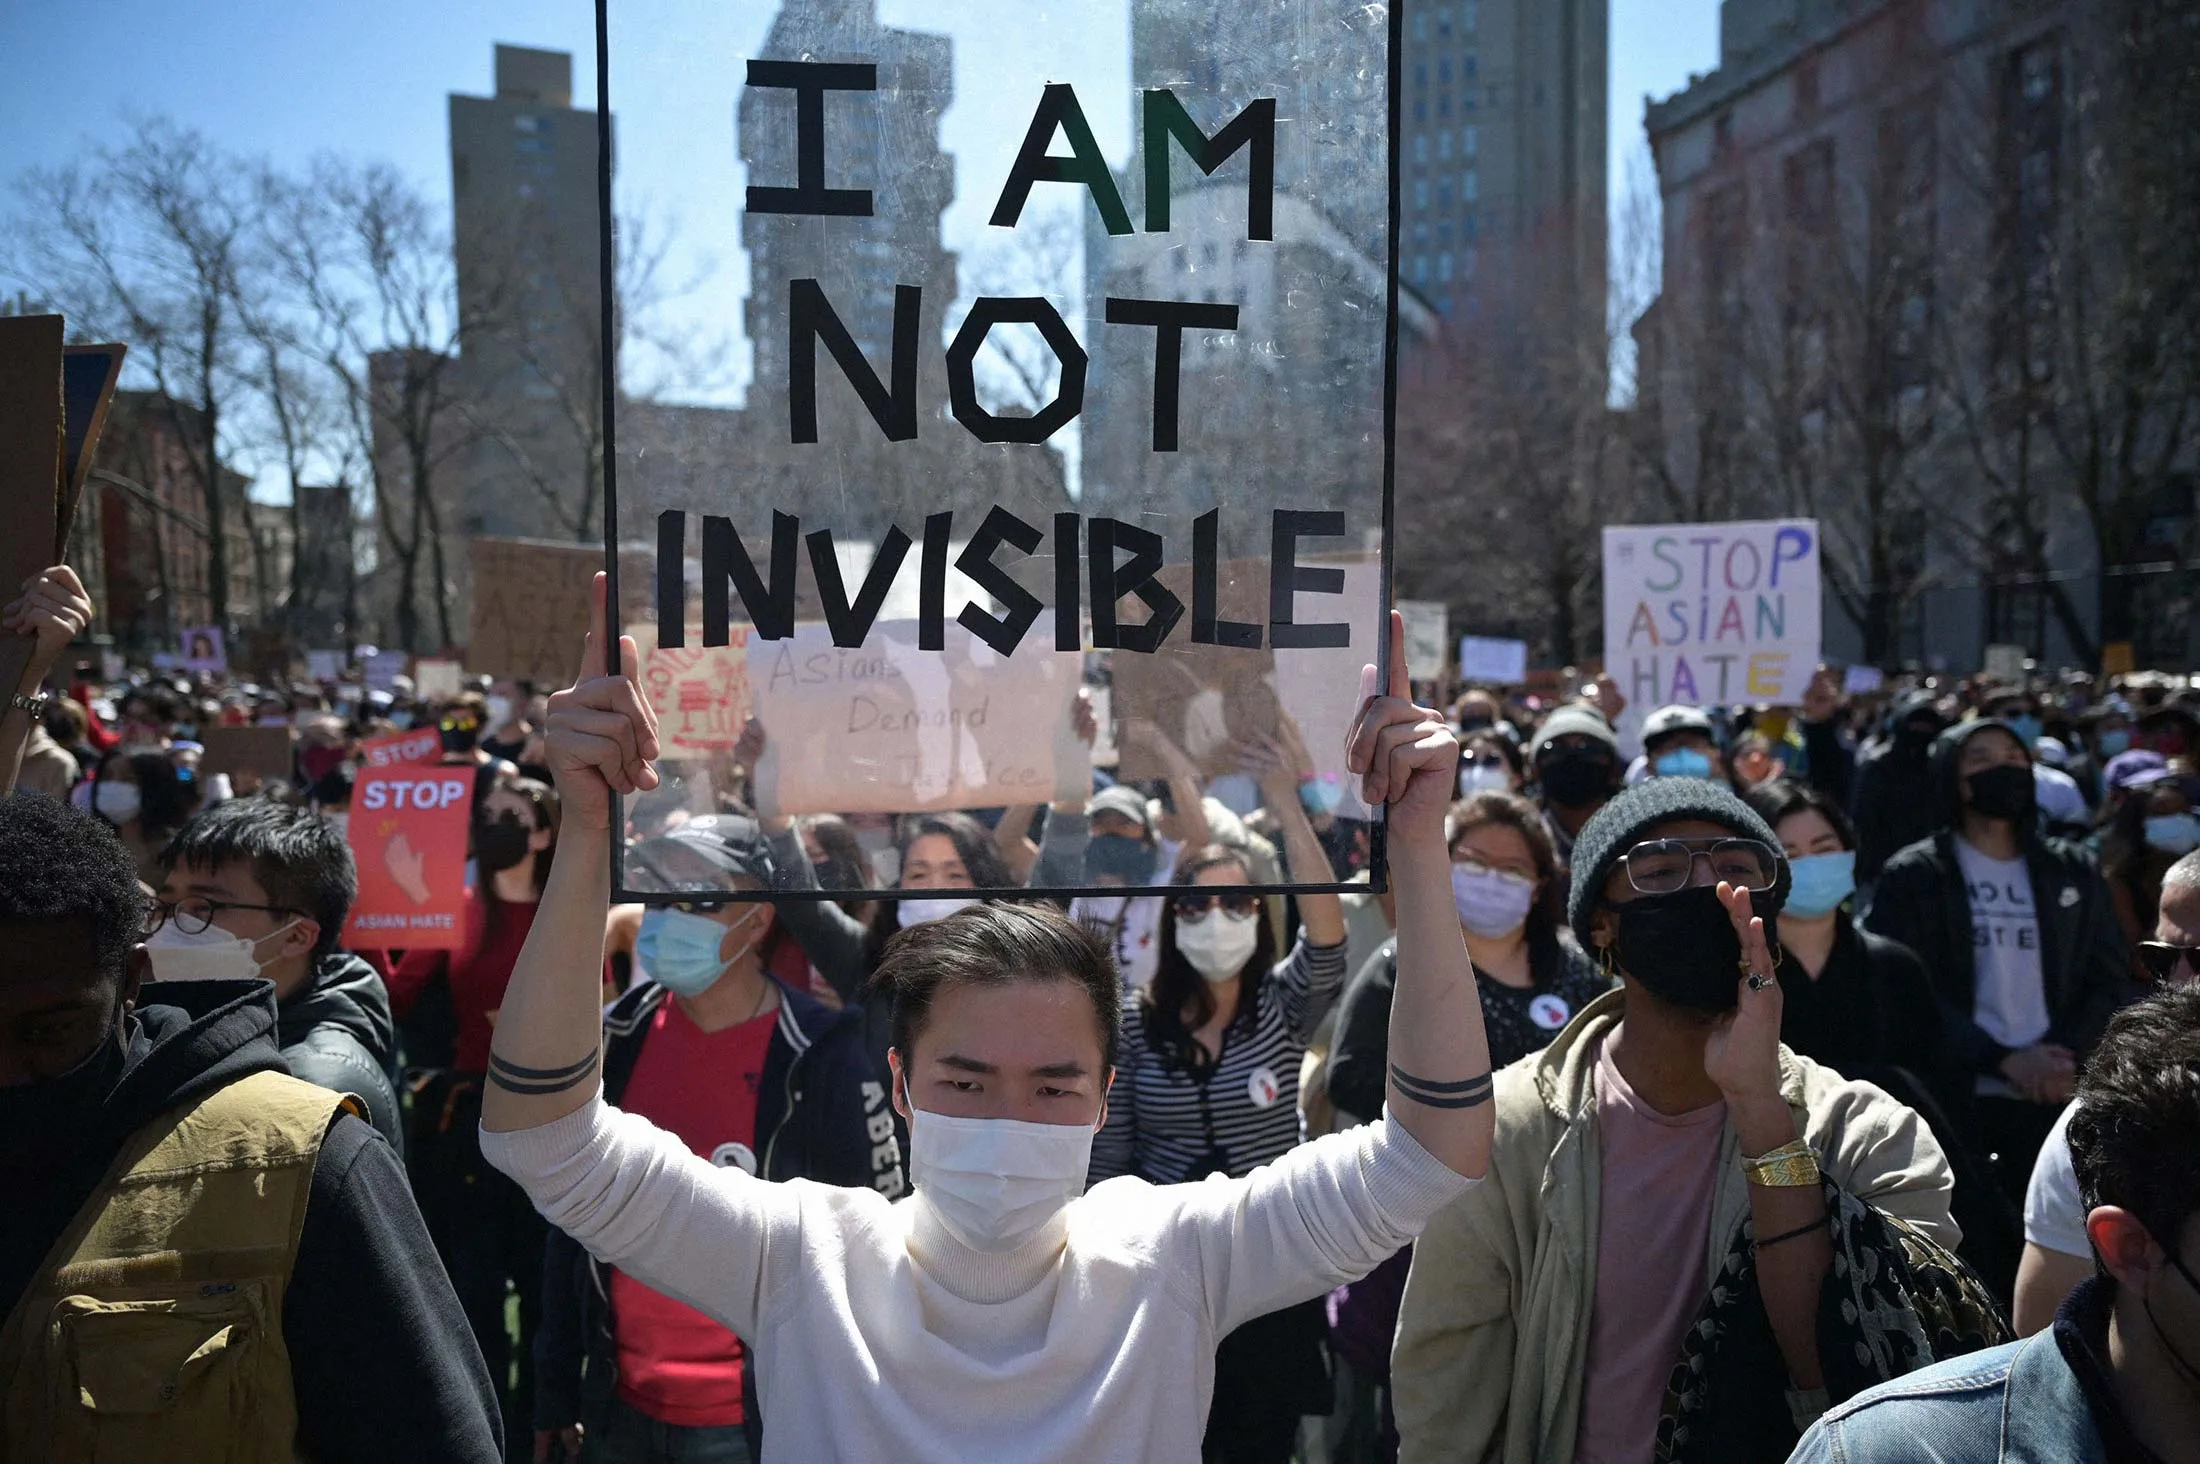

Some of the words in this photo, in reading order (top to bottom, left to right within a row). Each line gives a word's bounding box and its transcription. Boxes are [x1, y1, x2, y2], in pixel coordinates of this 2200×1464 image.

[746, 59, 877, 216] I
[989, 82, 1276, 241] AM
[790, 278, 1239, 452] NOT
[657, 505, 1350, 657] INVISIBLE
[1627, 594, 1785, 648] ASIAN
[1632, 652, 1790, 704] HATE
[848, 695, 989, 734] Demand
[371, 735, 436, 767] STOP
[363, 779, 465, 810] STOP
[354, 912, 407, 930] ASIAN
[409, 911, 455, 930] HATE
